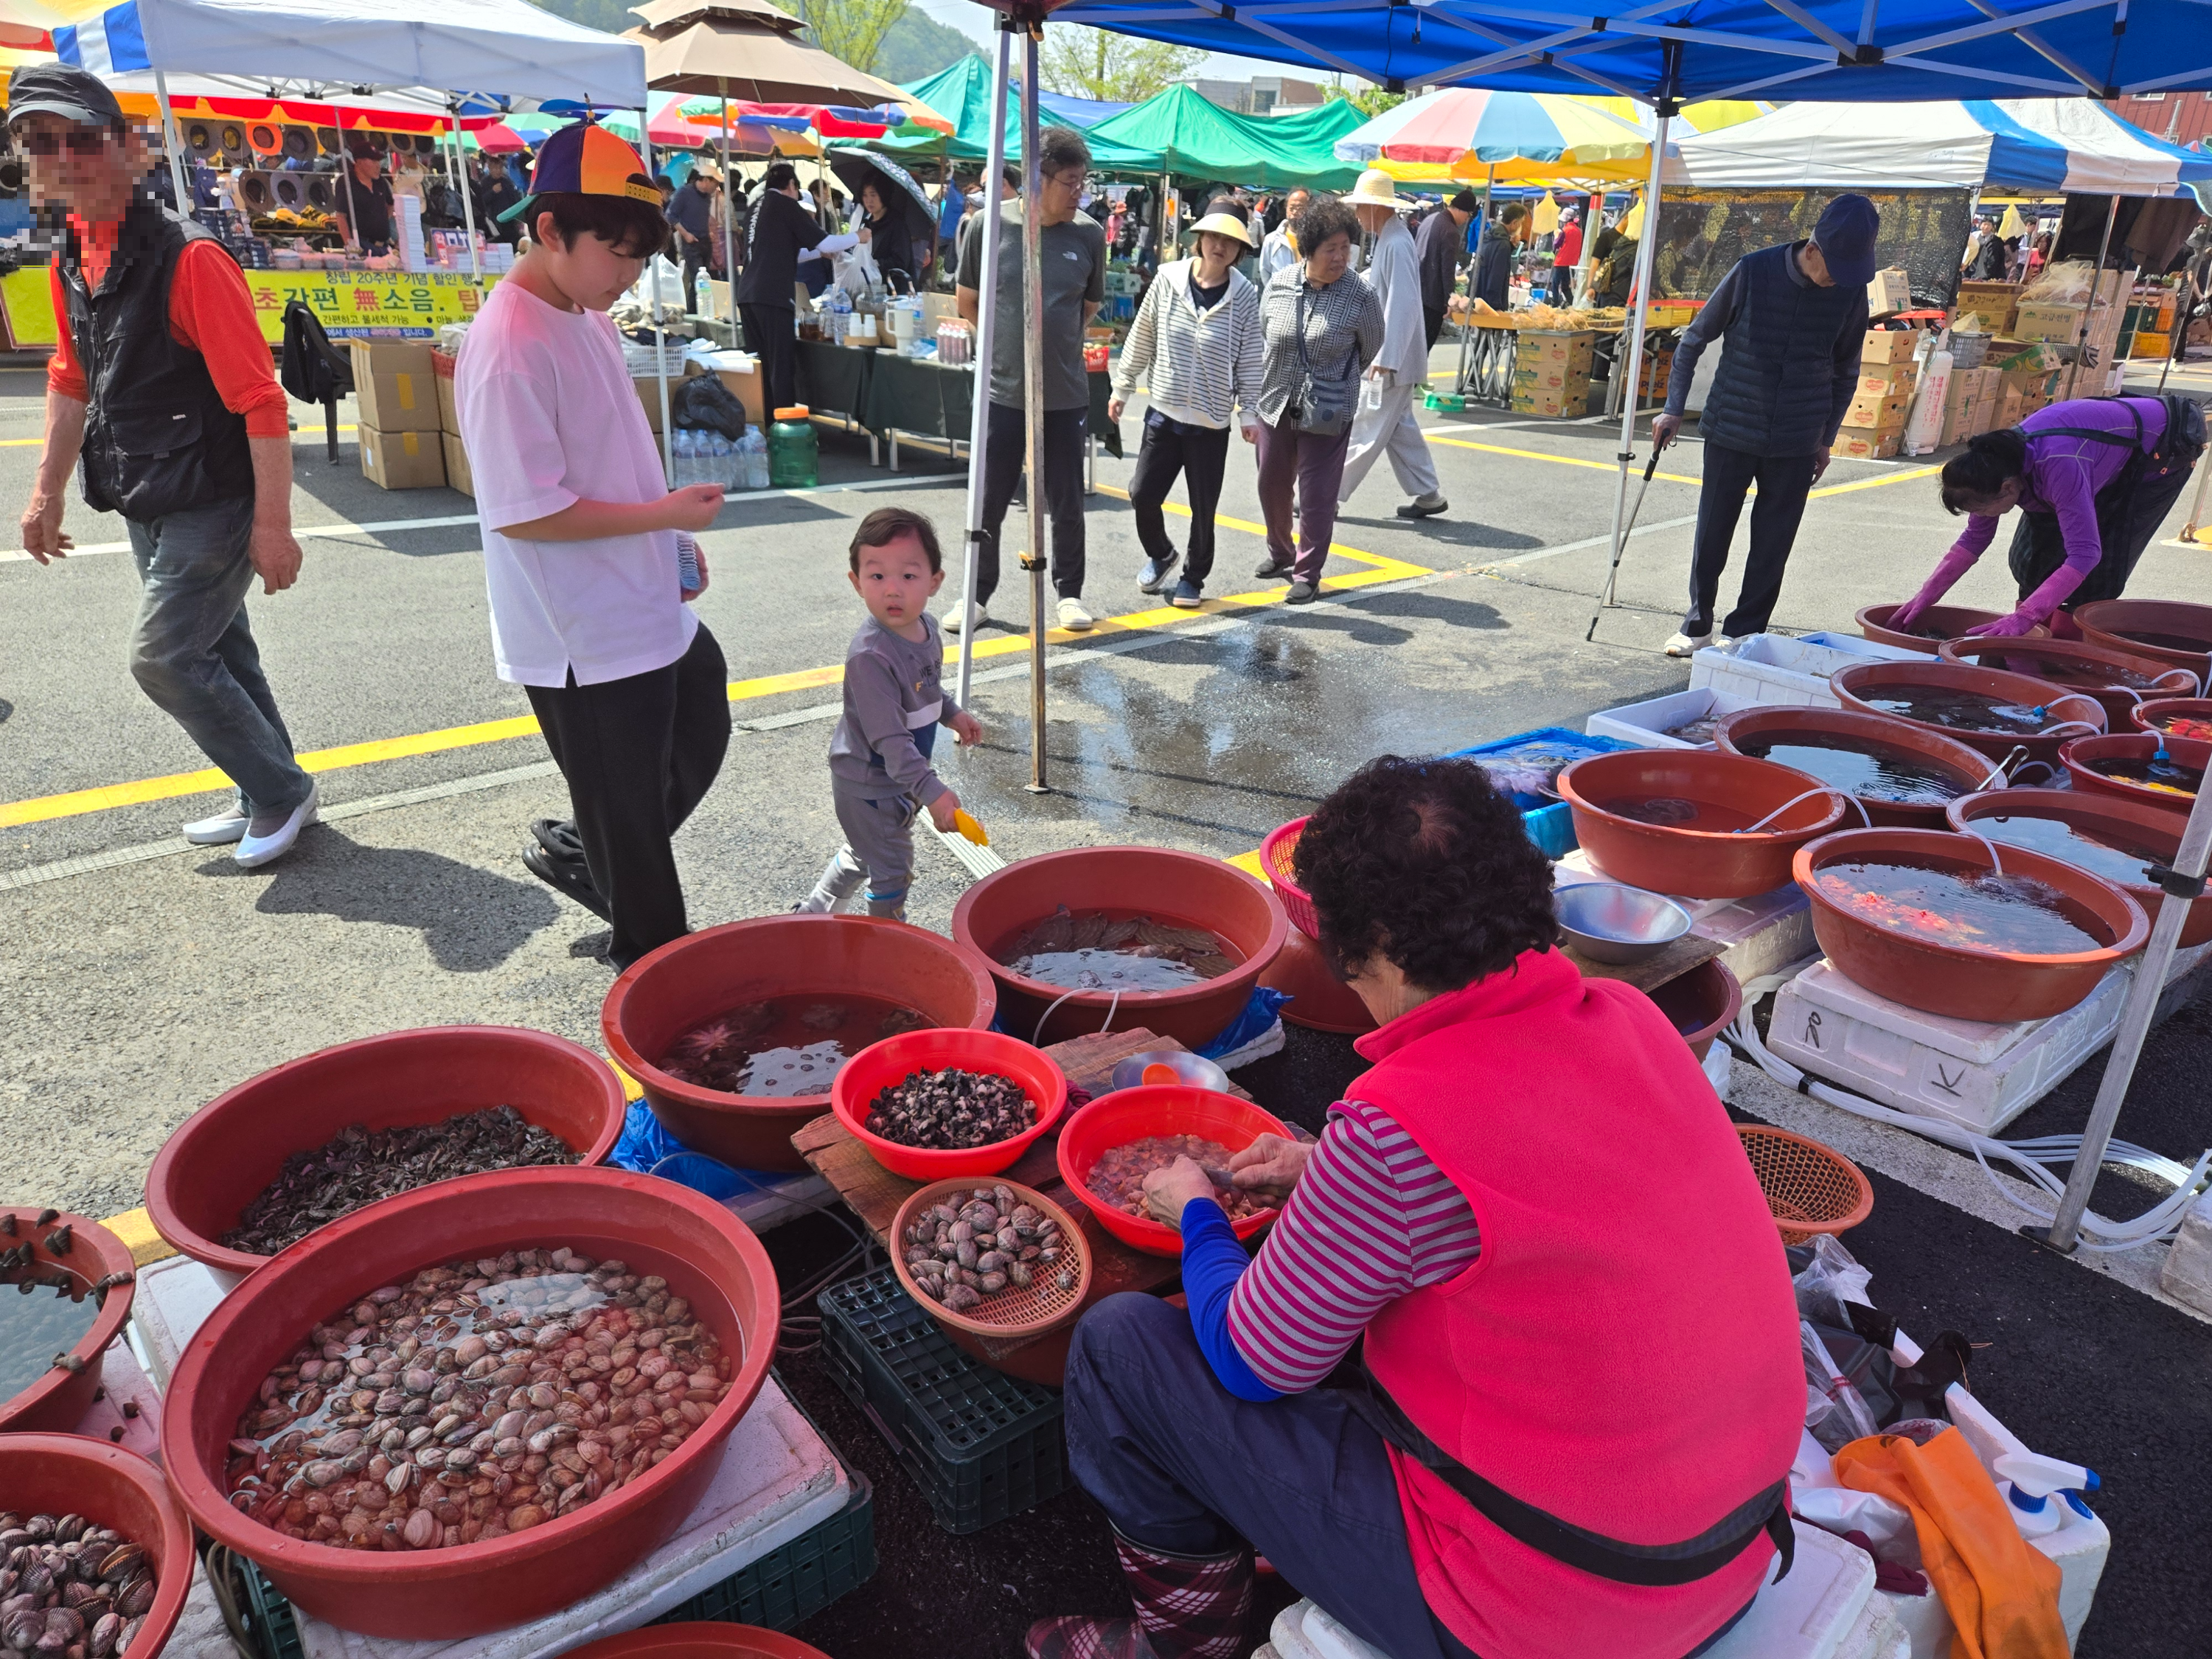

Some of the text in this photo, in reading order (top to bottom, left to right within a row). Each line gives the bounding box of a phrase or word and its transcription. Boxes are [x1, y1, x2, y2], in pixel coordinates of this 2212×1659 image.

[326, 271, 352, 284] 창립
[357, 272, 398, 285] 20주년
[404, 273, 428, 286] 기념
[434, 273, 457, 286] 할인
[323, 315, 359, 324] 간편하고
[362, 315, 389, 324] 물세척
[392, 315, 409, 324] 가능
[403, 328, 428, 337] 입니다.
[919, 665, 933, 678] WE
